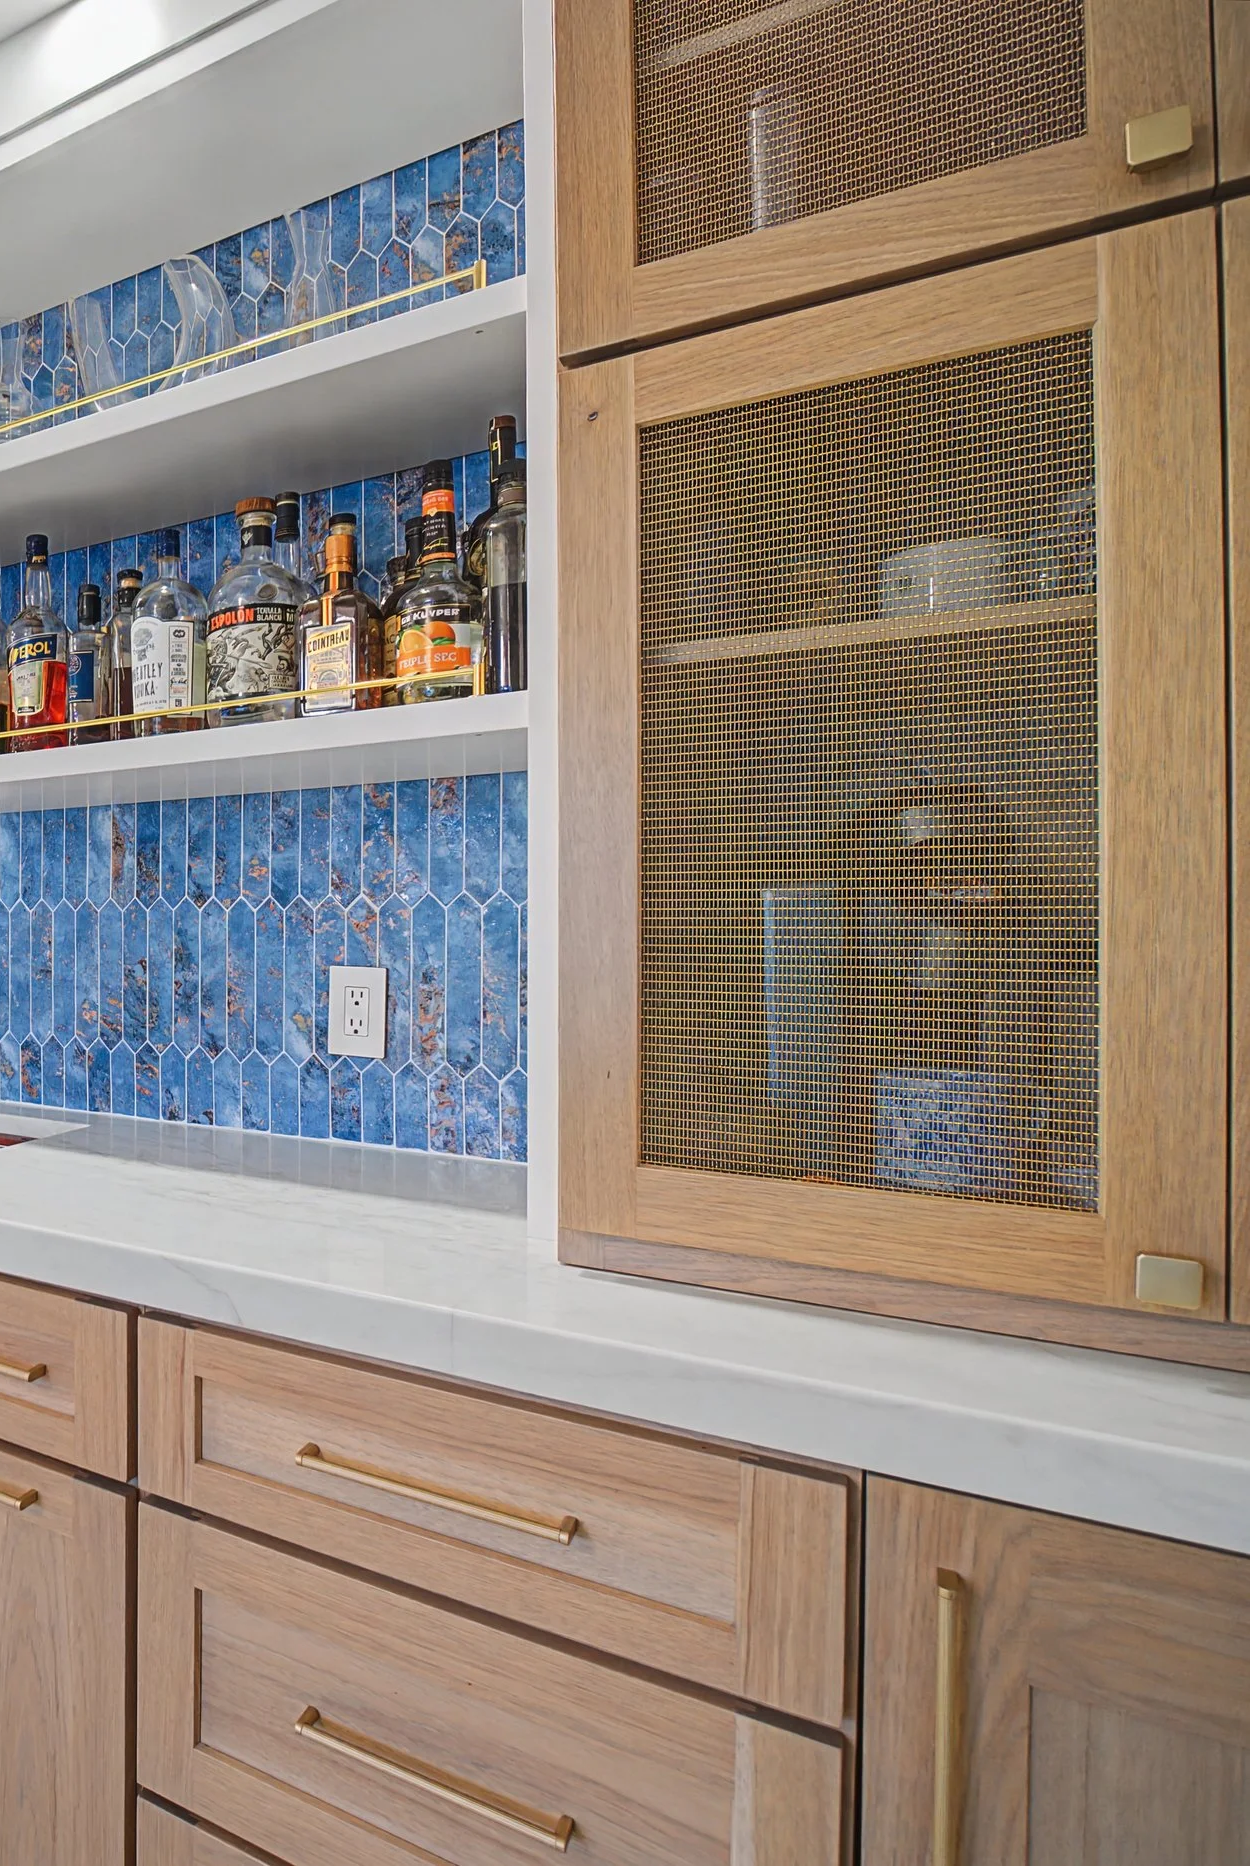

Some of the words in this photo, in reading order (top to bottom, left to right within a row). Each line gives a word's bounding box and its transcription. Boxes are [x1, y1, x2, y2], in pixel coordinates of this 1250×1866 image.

[413, 608, 460, 621] KUYPER
[308, 628, 350, 654] COINTREAU
[434, 652, 457, 663] SEC
